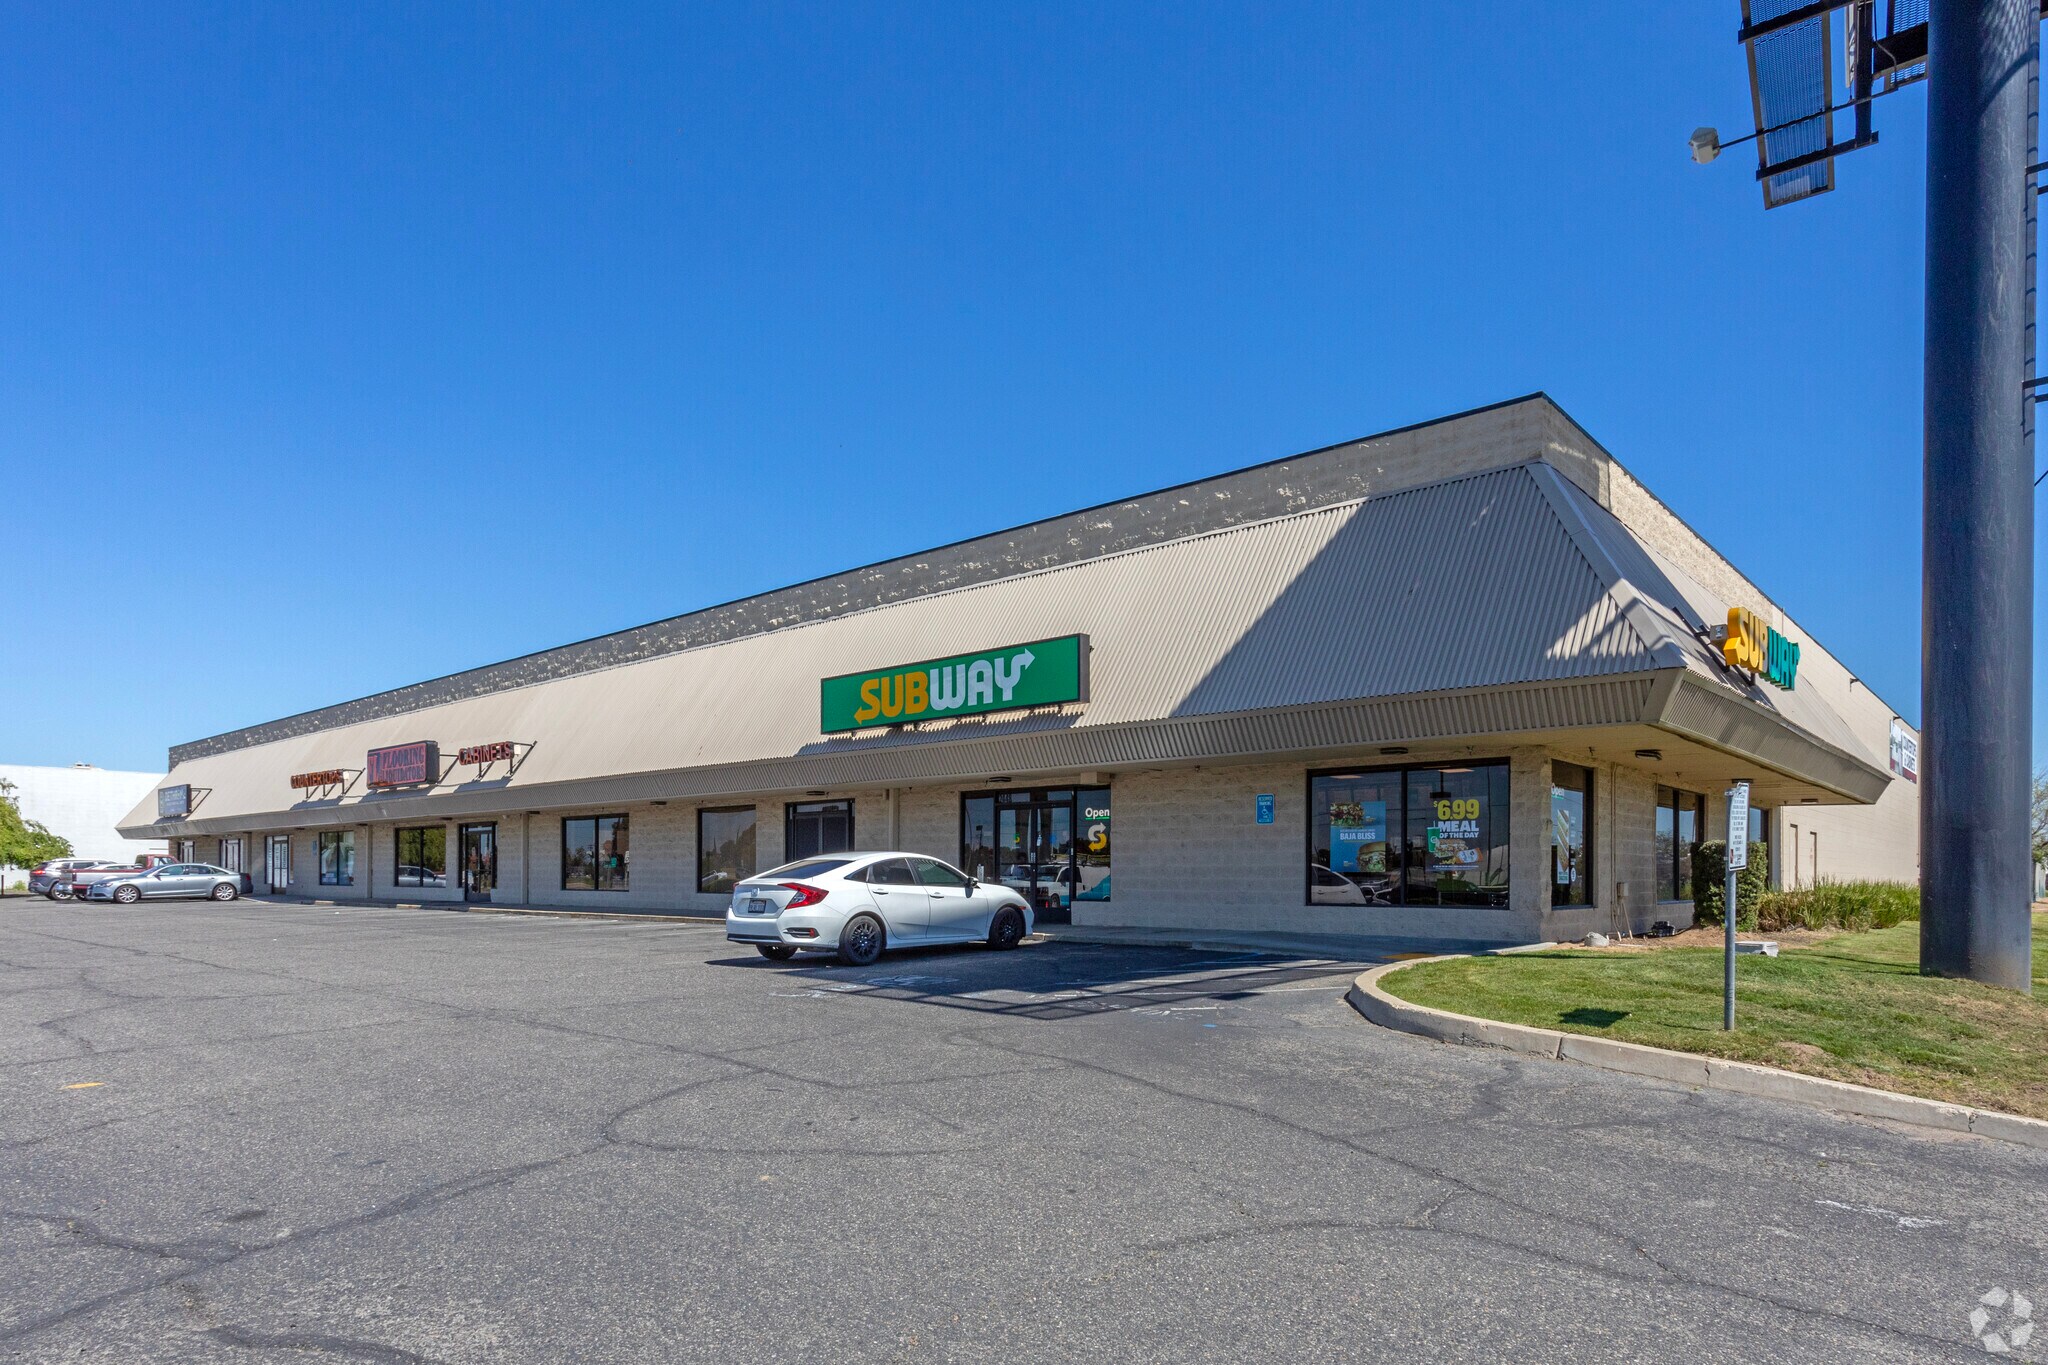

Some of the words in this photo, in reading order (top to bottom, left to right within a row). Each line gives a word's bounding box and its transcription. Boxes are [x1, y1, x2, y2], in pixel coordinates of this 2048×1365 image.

[1724, 606, 1800, 691] SUBWAY
[854, 648, 1035, 725] SUBWAY
[383, 745, 424, 768] FLOORING
[459, 741, 514, 766] CABINETS
[1085, 808, 1110, 820] Open
[1433, 799, 1480, 820] $6.99
[1340, 832, 1357, 840] BAJA
[1357, 832, 1376, 840] BLISS
[1438, 820, 1480, 832] MEAL
